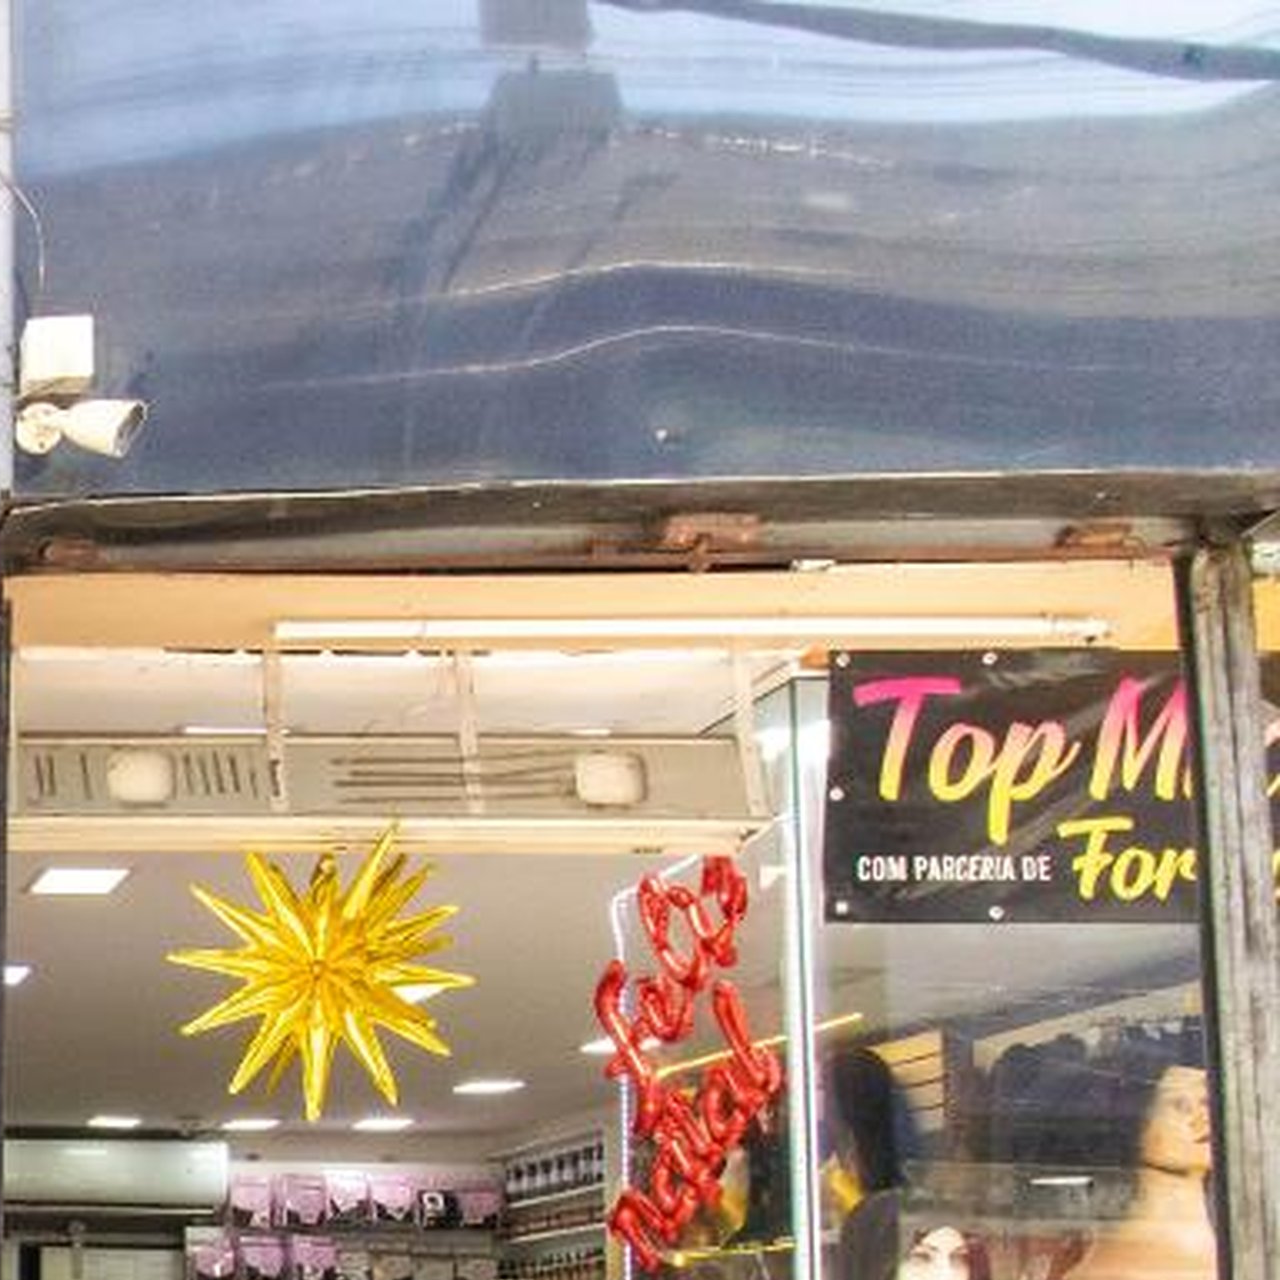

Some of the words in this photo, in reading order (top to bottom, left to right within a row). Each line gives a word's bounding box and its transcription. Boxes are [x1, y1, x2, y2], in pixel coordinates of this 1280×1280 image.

[853, 675, 1081, 845] Top
[1088, 674, 1193, 800] M
[856, 856, 907, 881] COM
[915, 855, 1015, 882] PARCERIA
[1022, 854, 1052, 881] DE
[1056, 815, 1198, 900] For
